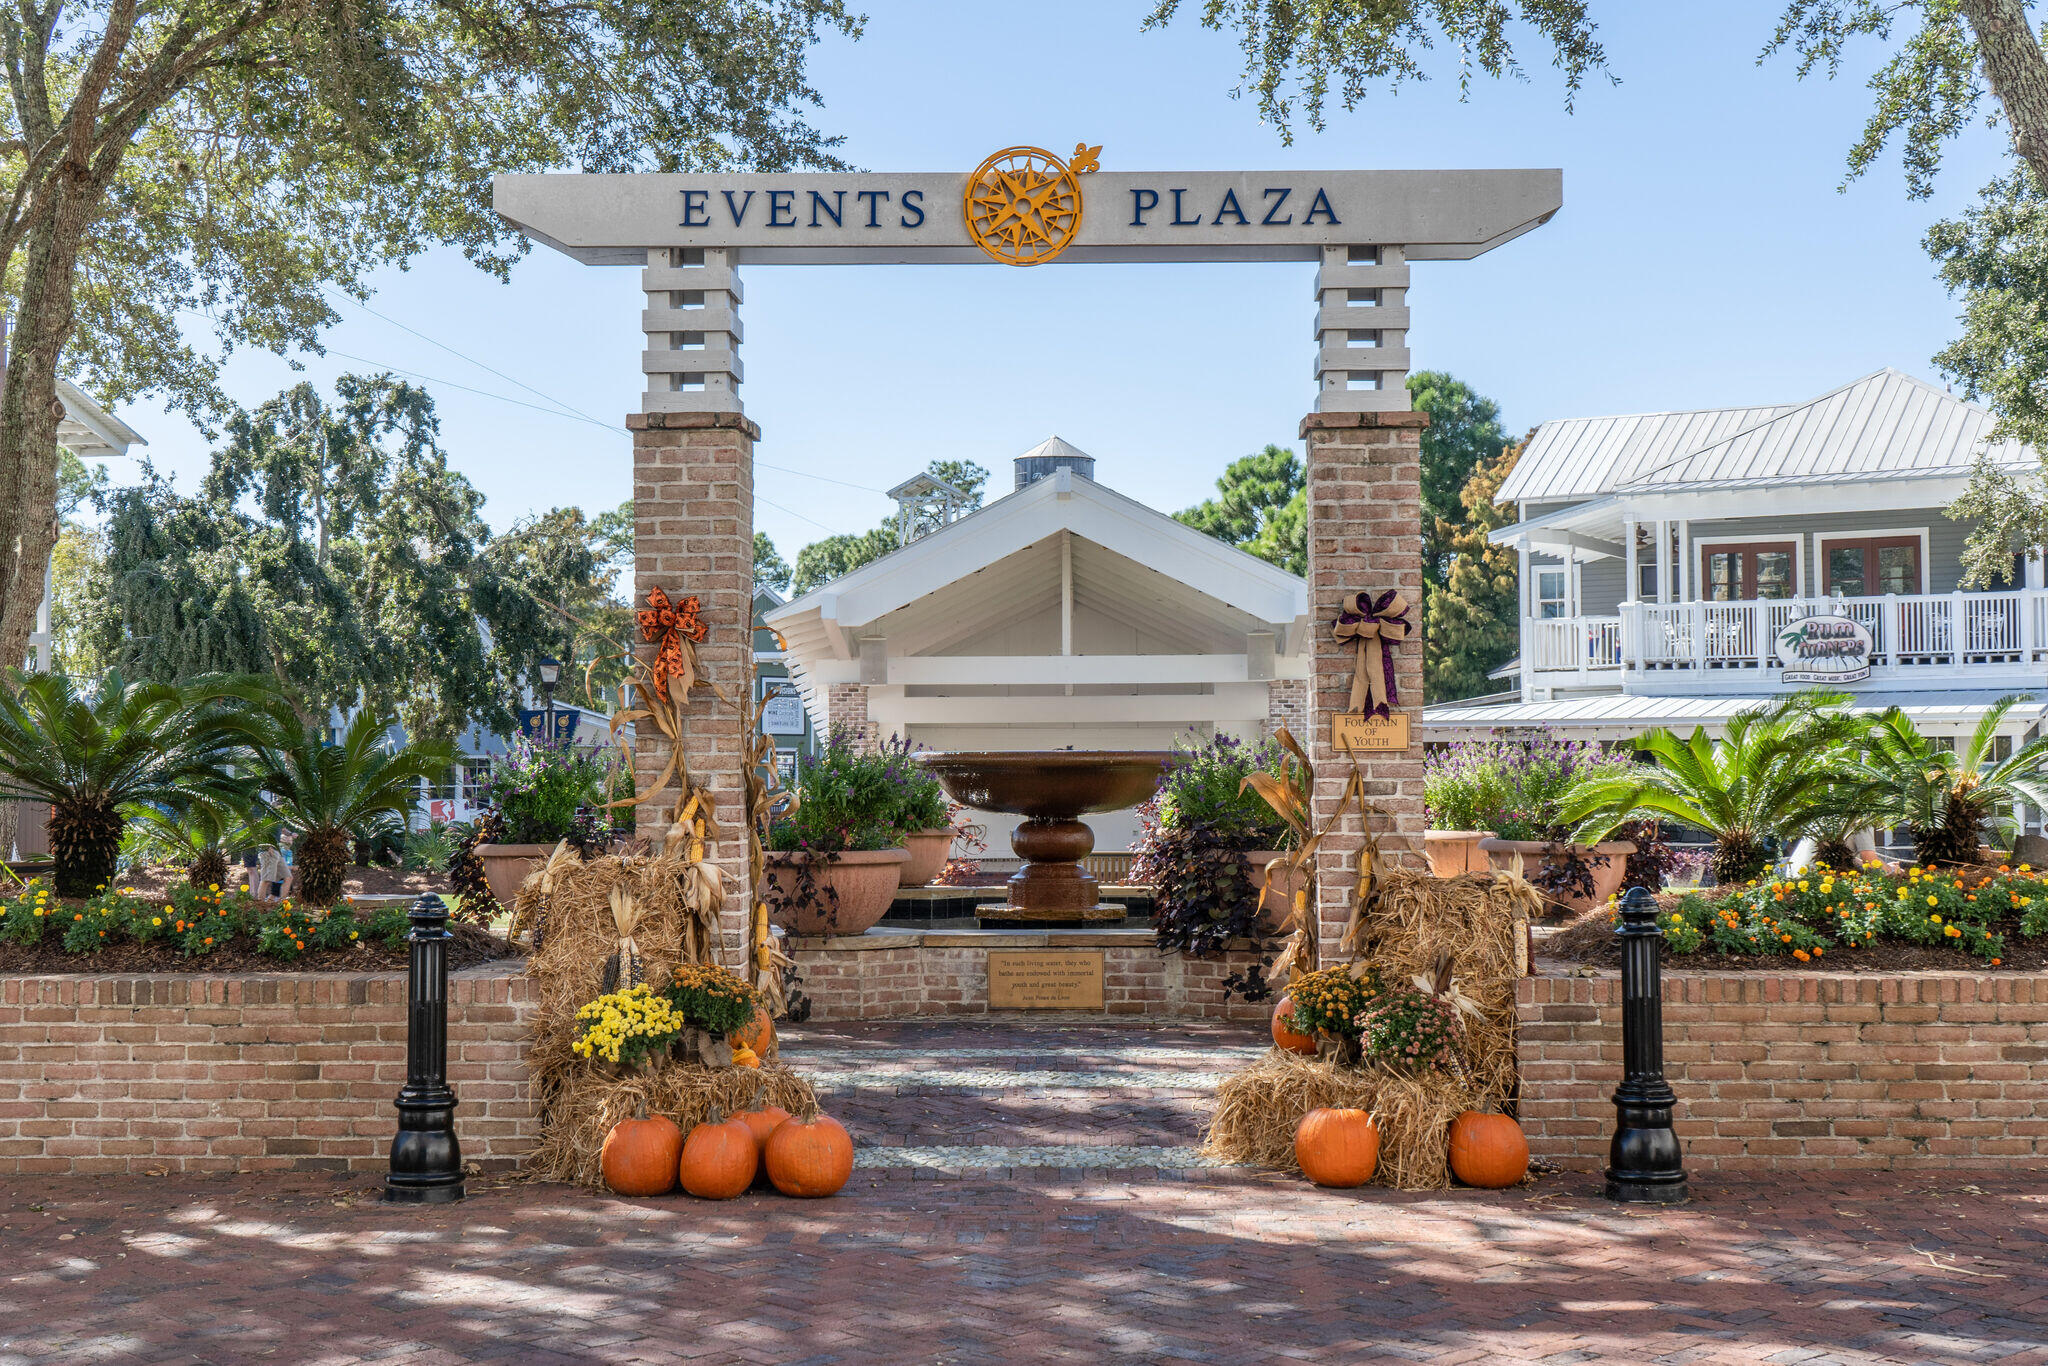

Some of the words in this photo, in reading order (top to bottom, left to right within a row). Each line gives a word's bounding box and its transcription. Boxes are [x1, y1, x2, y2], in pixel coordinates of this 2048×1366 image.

[679, 189, 925, 229] EVENTS
[1130, 187, 1342, 226] PLAZA
[1345, 718, 1397, 727] FOUNTAIN
[1365, 728, 1377, 736] OF
[1354, 736, 1389, 746] YOUTH
